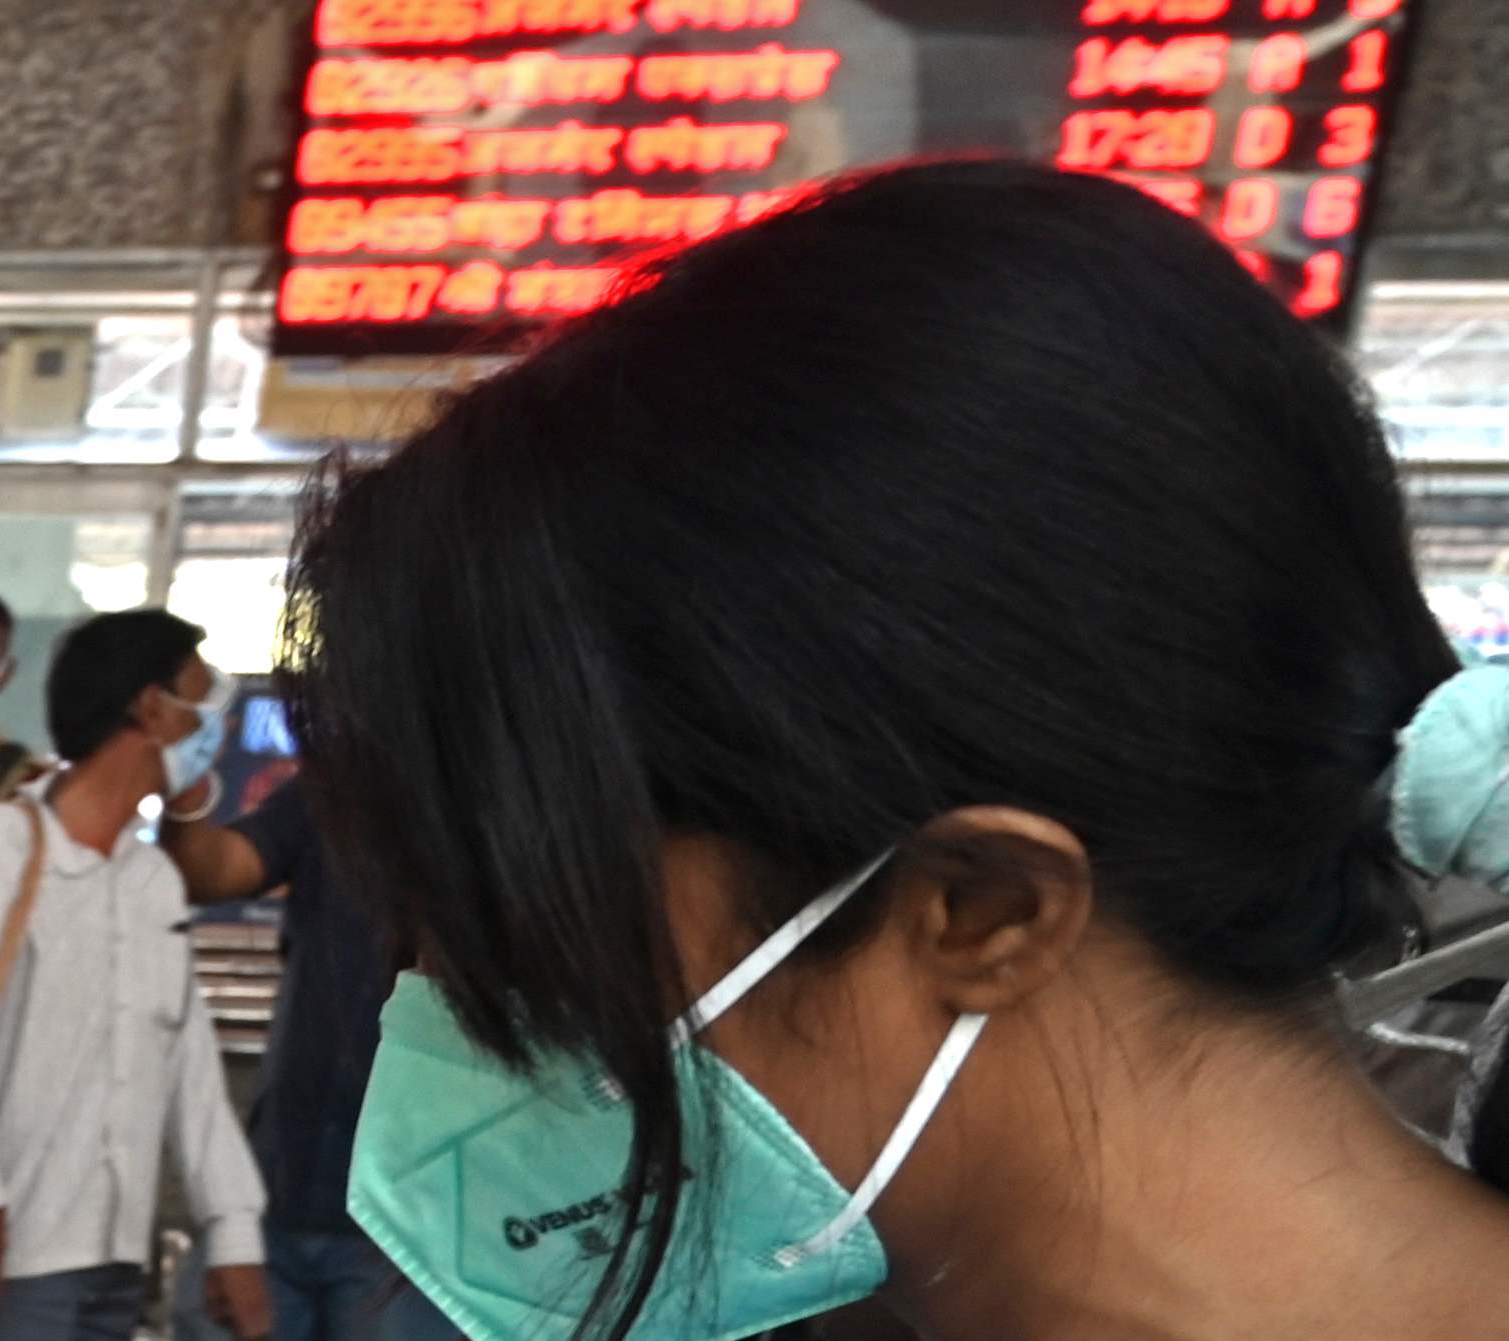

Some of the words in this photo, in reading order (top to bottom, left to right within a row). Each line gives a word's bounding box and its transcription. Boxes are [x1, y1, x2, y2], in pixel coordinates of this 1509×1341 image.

[1341, 29, 1387, 92] 1
[1317, 104, 1377, 167] 3
[1302, 175, 1362, 239] 6
[1290, 250, 1342, 319] 1
